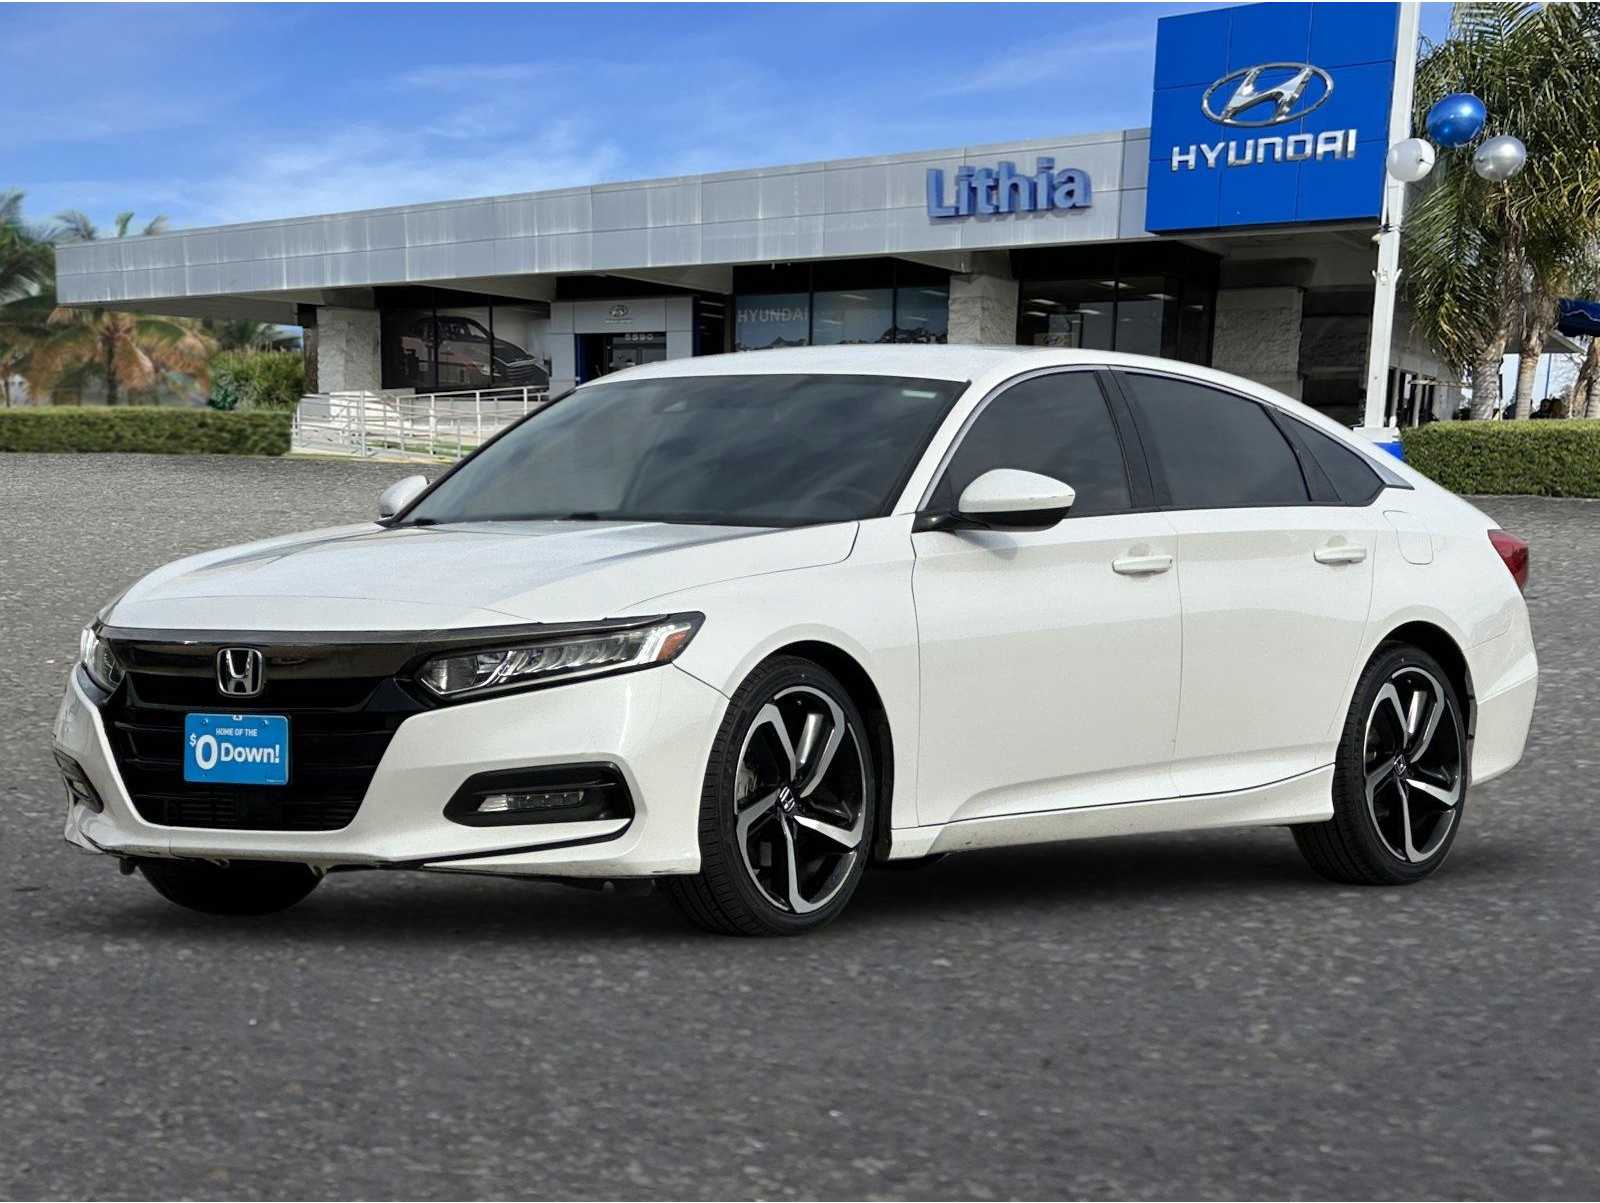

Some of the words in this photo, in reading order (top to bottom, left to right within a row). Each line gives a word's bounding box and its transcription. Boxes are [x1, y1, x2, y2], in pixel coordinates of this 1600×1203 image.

[1171, 129, 1357, 171] HYUNDAI
[927, 156, 1092, 218] Lithia
[737, 307, 809, 323] HYUNDAI
[215, 727, 234, 736] HOME
[234, 728, 243, 736] OF
[245, 728, 258, 737] THE
[220, 742, 280, 764] Down!
